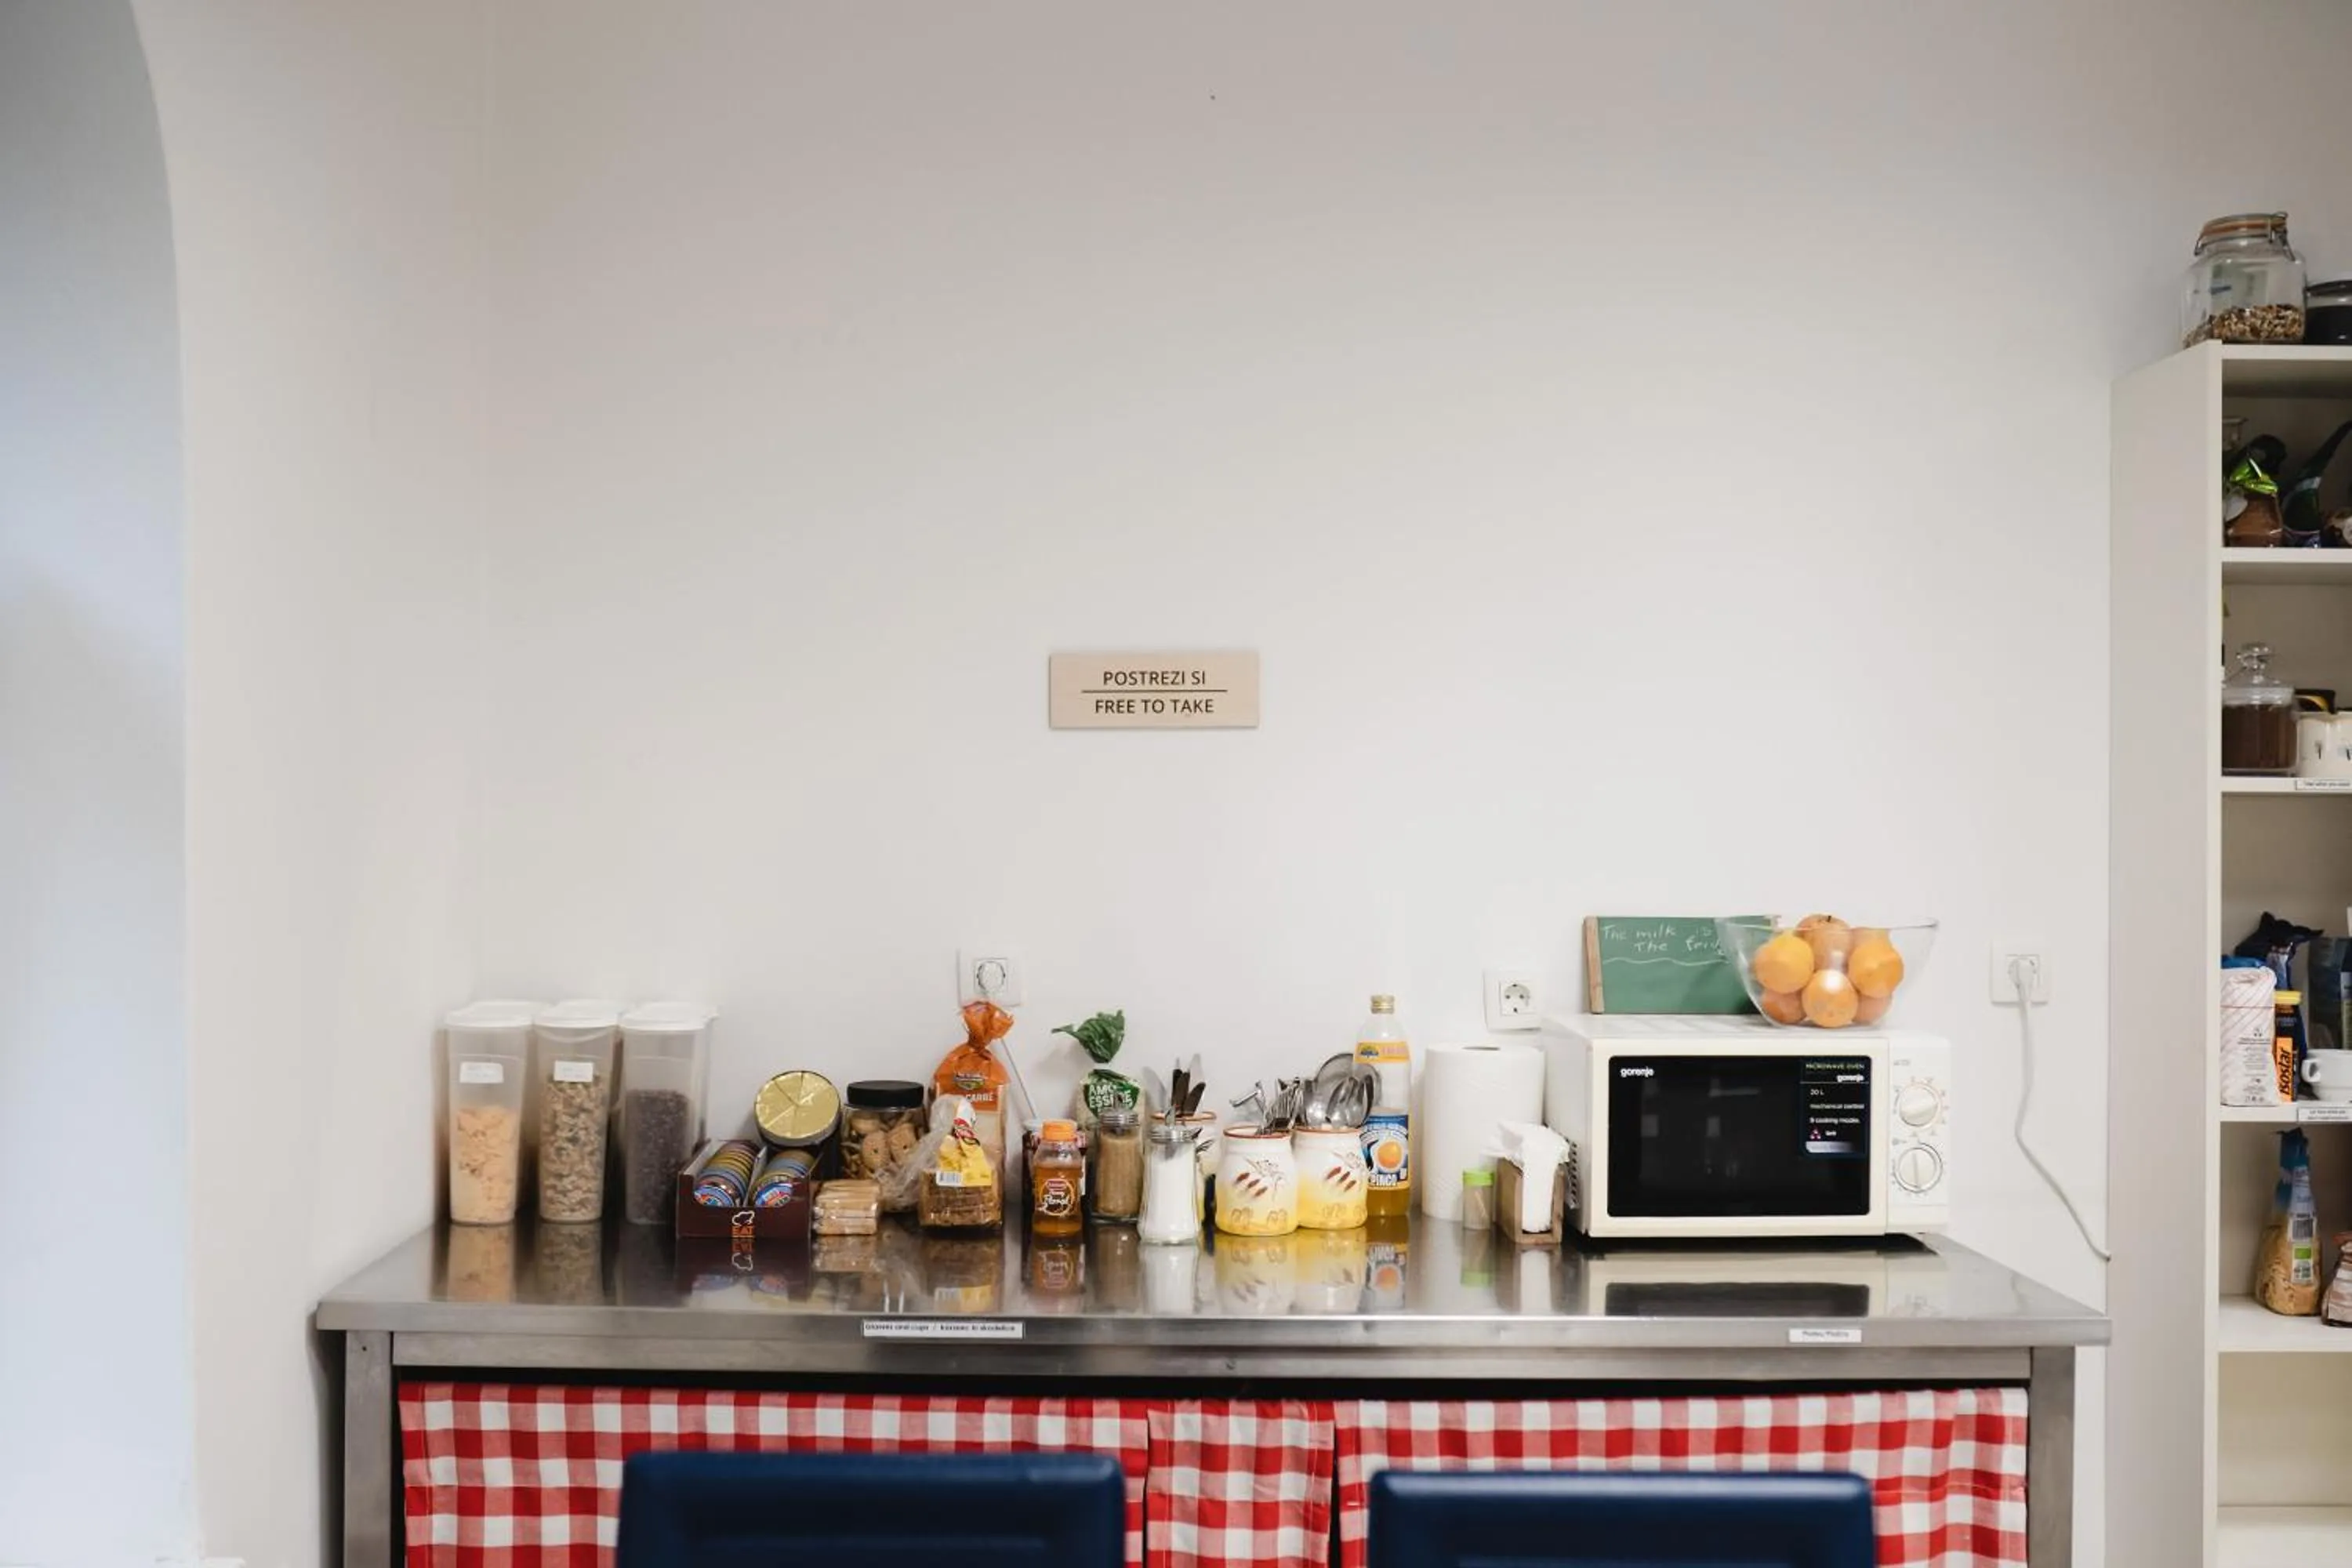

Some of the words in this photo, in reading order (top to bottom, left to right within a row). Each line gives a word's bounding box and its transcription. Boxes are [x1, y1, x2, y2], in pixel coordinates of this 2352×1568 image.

[1102, 670, 1185, 686] POSTREZI
[1191, 670, 1205, 685] SI
[1095, 699, 1136, 714] FREE
[1141, 699, 1165, 713] TO
[1170, 699, 1214, 713] TAKE
[1603, 924, 1627, 941] The
[1636, 922, 1677, 939] milk
[1621, 1066, 1654, 1078] gorenje
